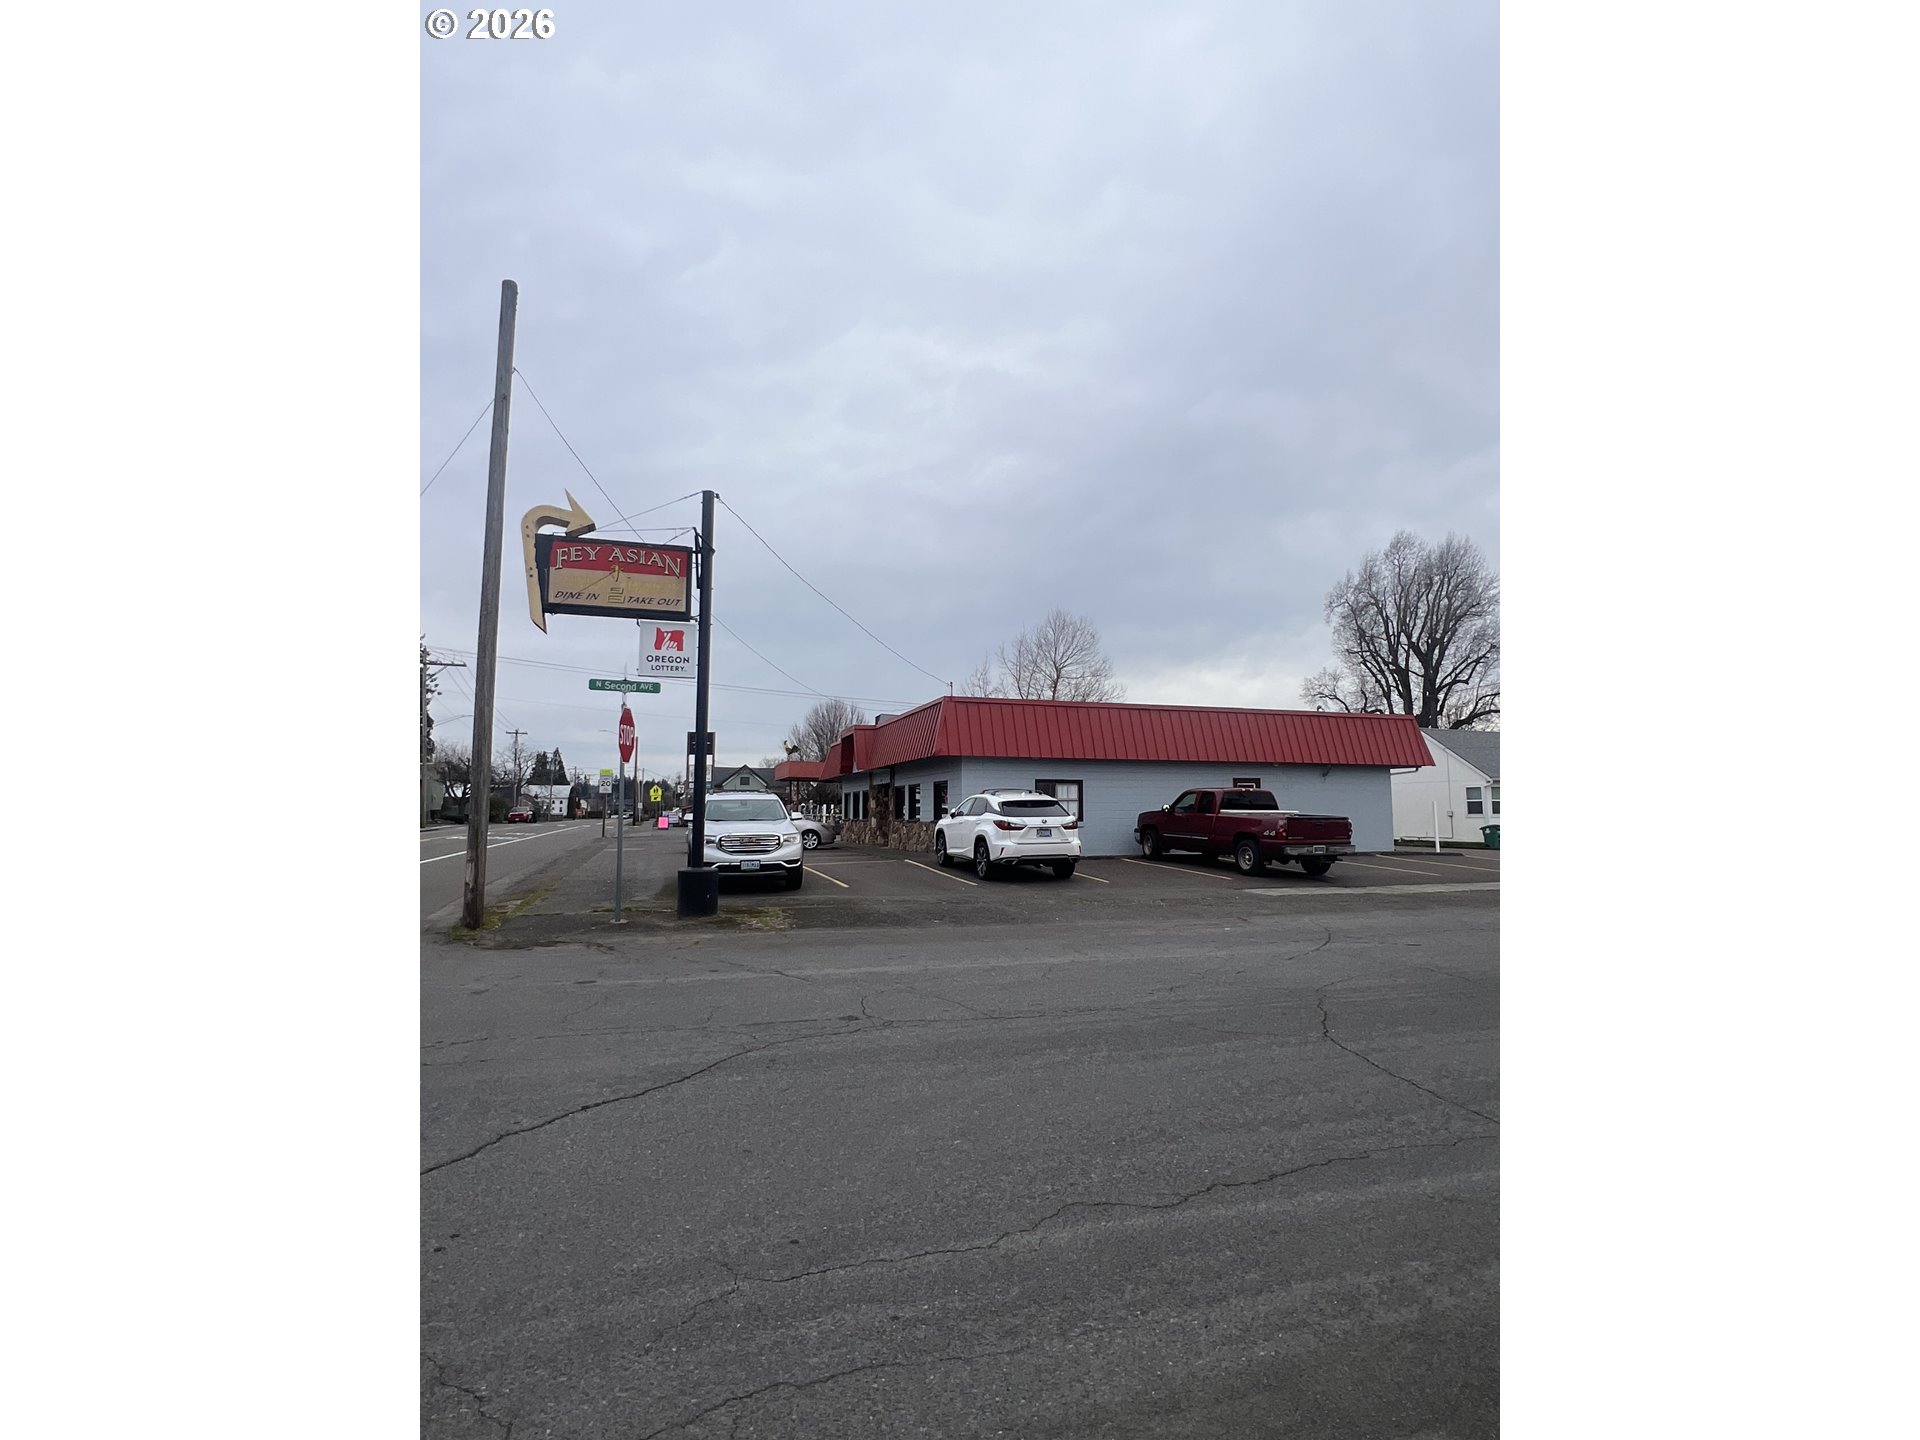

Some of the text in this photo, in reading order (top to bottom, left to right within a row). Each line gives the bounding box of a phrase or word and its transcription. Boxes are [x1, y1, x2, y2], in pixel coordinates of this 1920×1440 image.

[555, 546, 682, 578] FEY ASIAN
[554, 590, 601, 601] DINE IN
[627, 595, 682, 607] TAKE OUT
[646, 654, 690, 664] OREGON
[596, 680, 654, 692] N Second AVE
[620, 724, 635, 746] STOP
